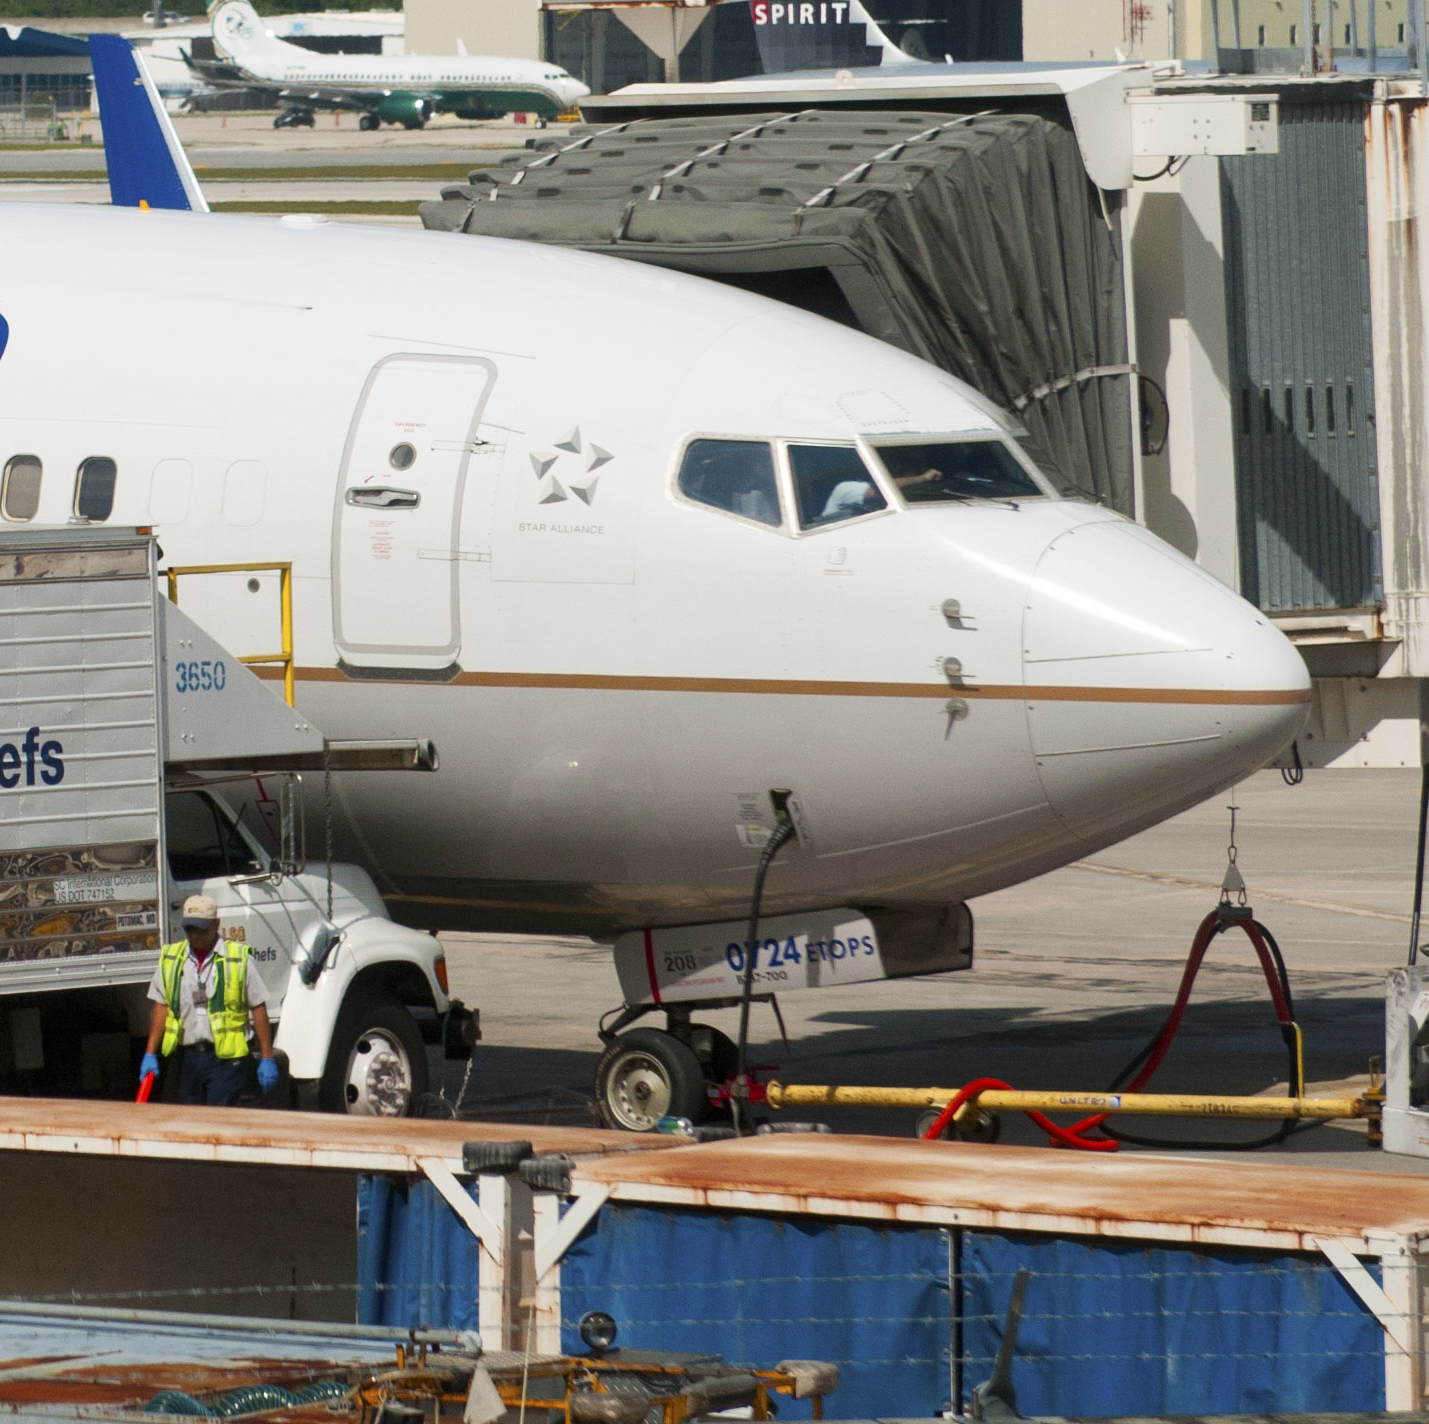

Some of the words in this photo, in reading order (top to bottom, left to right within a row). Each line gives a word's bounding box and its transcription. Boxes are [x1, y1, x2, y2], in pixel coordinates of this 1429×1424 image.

[754, 2, 847, 25] SPIRIT
[518, 522, 547, 533] STAR
[550, 524, 605, 535] ALLIANCE
[175, 660, 227, 694] 3650
[68, 890, 85, 902] DOT
[252, 947, 277, 962] hefs
[805, 935, 875, 963] ETOPS
[664, 955, 697, 973] 208
[735, 969, 789, 985] B37-700
